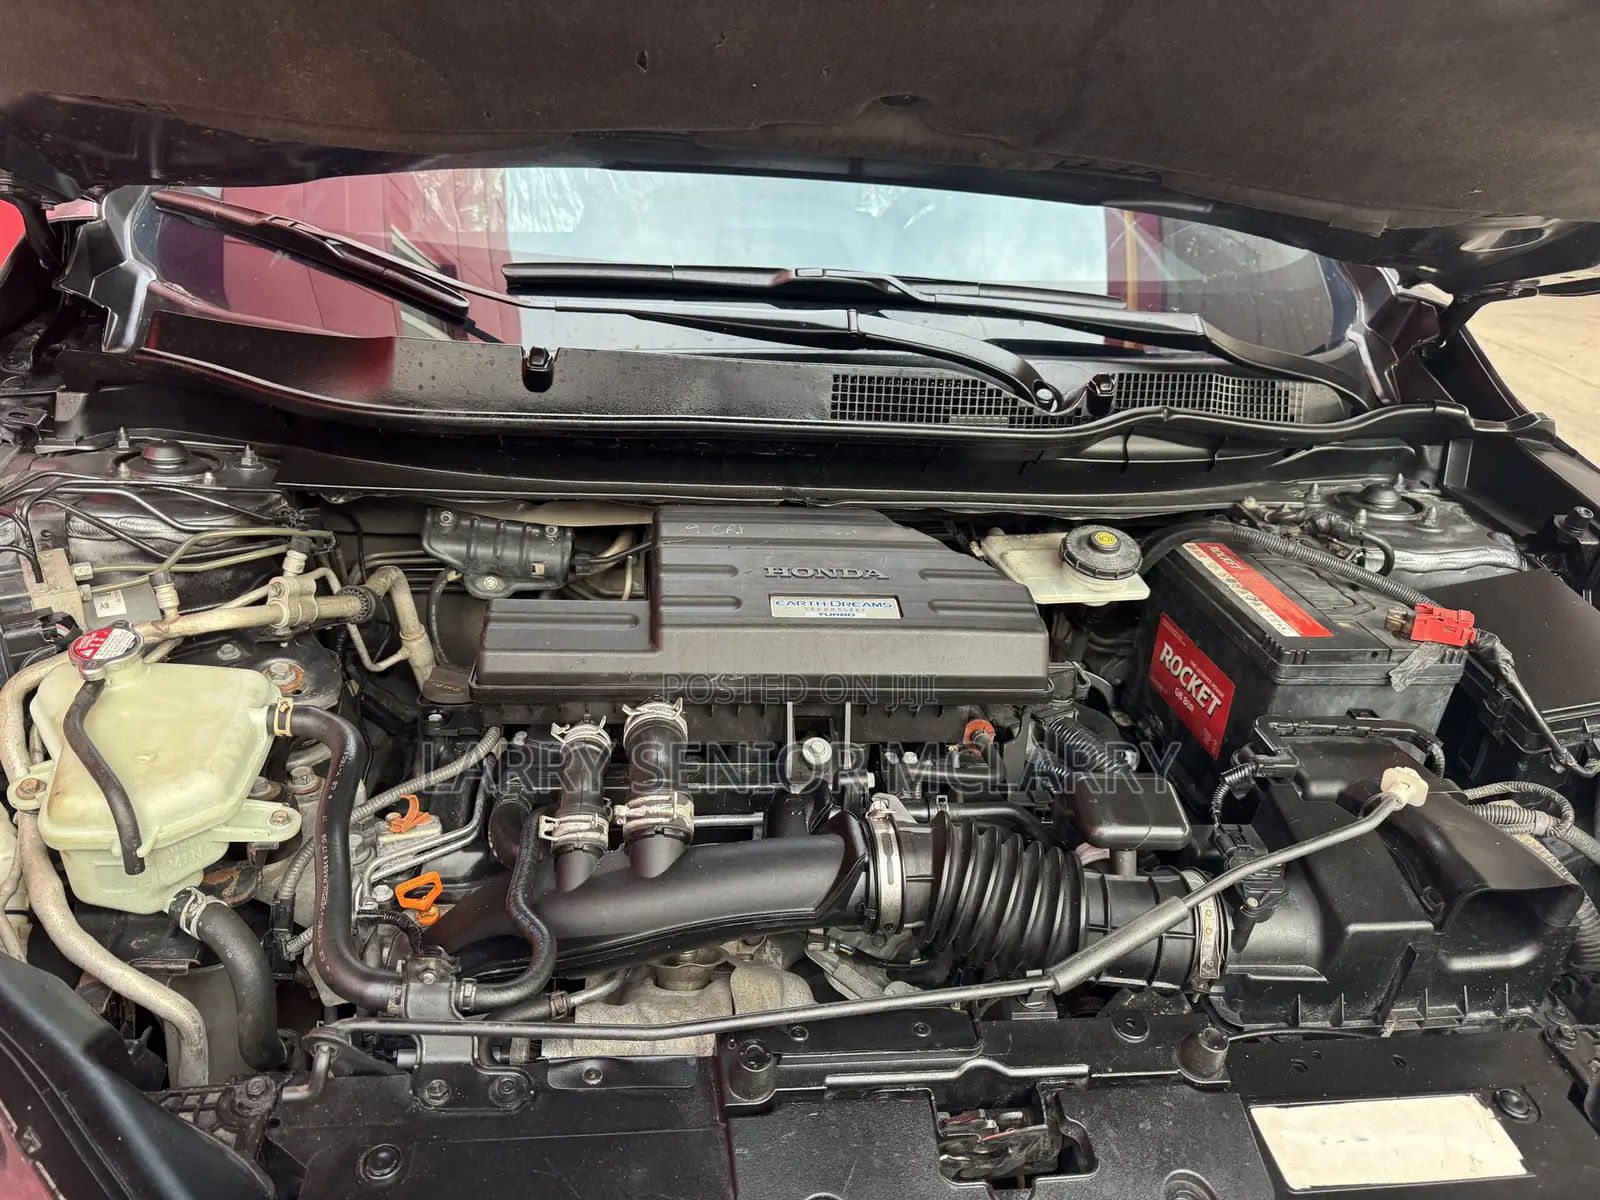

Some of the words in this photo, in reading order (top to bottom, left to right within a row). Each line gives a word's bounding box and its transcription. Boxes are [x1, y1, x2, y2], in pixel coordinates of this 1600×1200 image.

[764, 566, 890, 580] HONDA
[100, 602, 110, 610] A9
[830, 600, 893, 608] DREAMS
[1159, 641, 1222, 717] ROCKET
